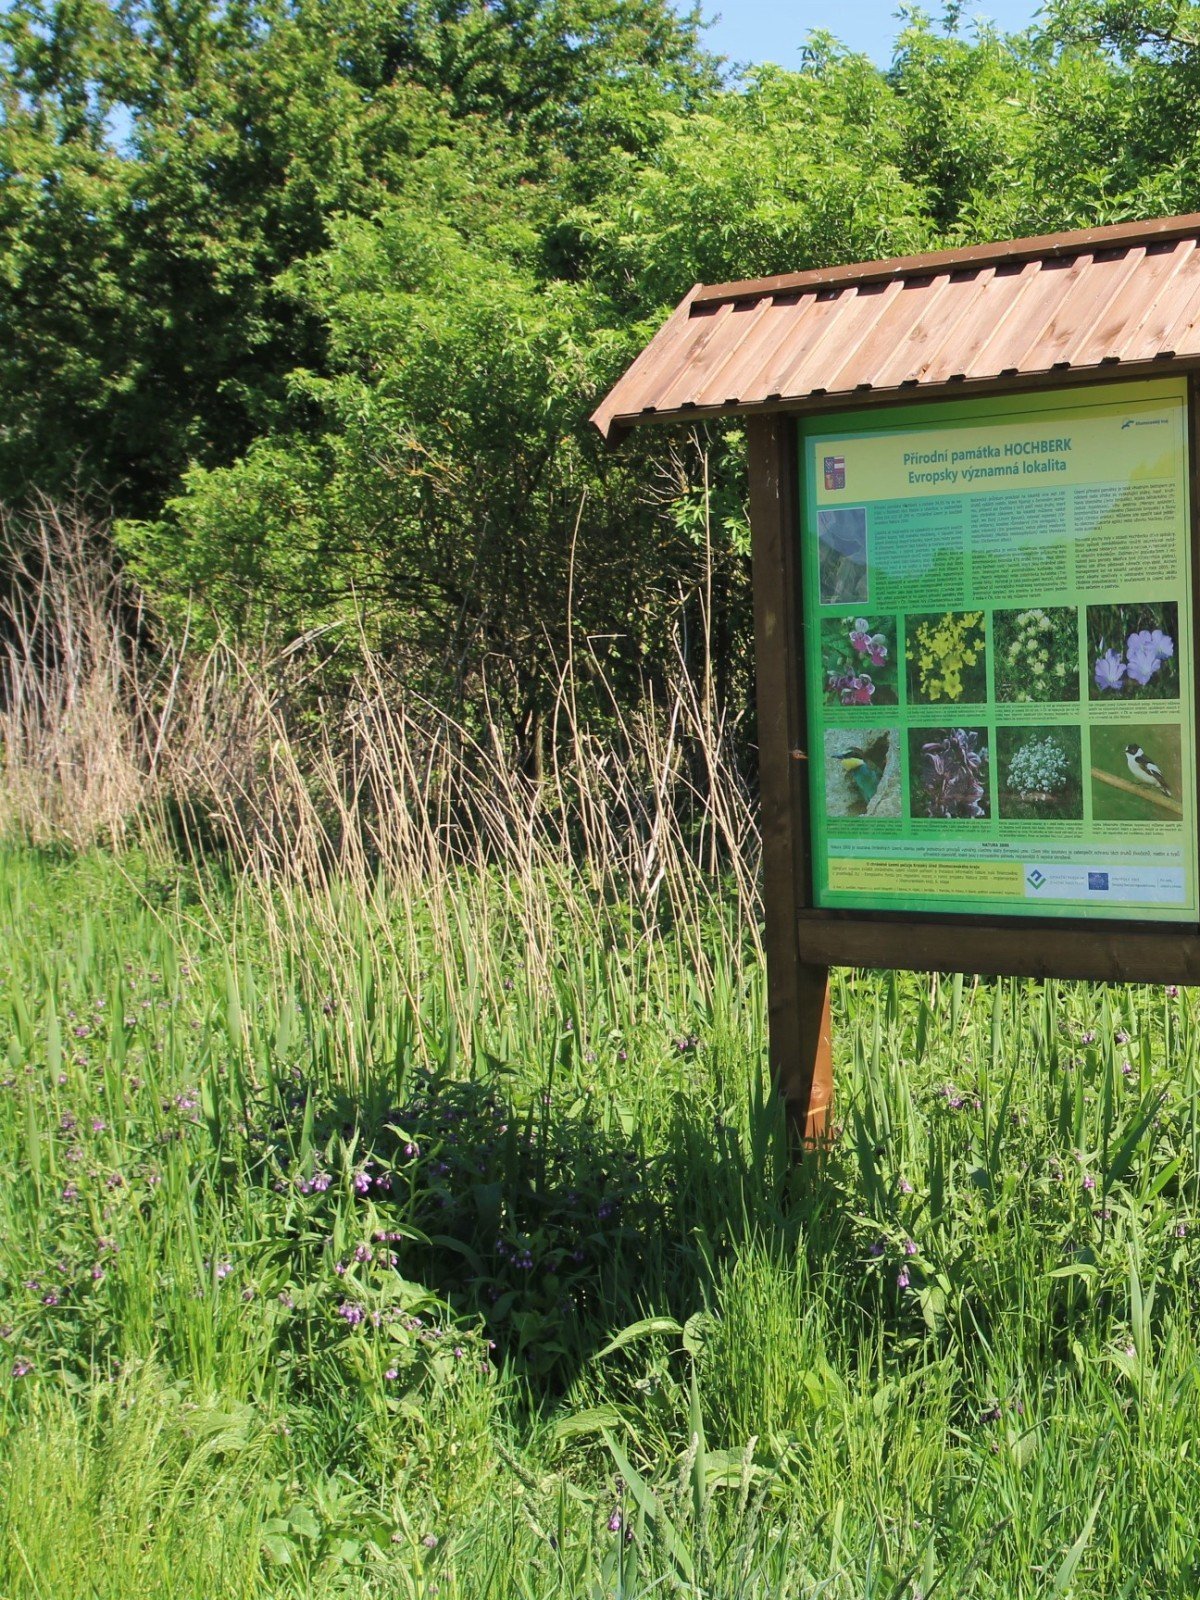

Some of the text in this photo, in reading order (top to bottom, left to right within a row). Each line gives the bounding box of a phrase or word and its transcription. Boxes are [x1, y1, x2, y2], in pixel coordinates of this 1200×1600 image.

[903, 438, 1072, 465] Přírodní památka HOCHBERK
[908, 458, 1067, 485] Evropsky významná lokalita
